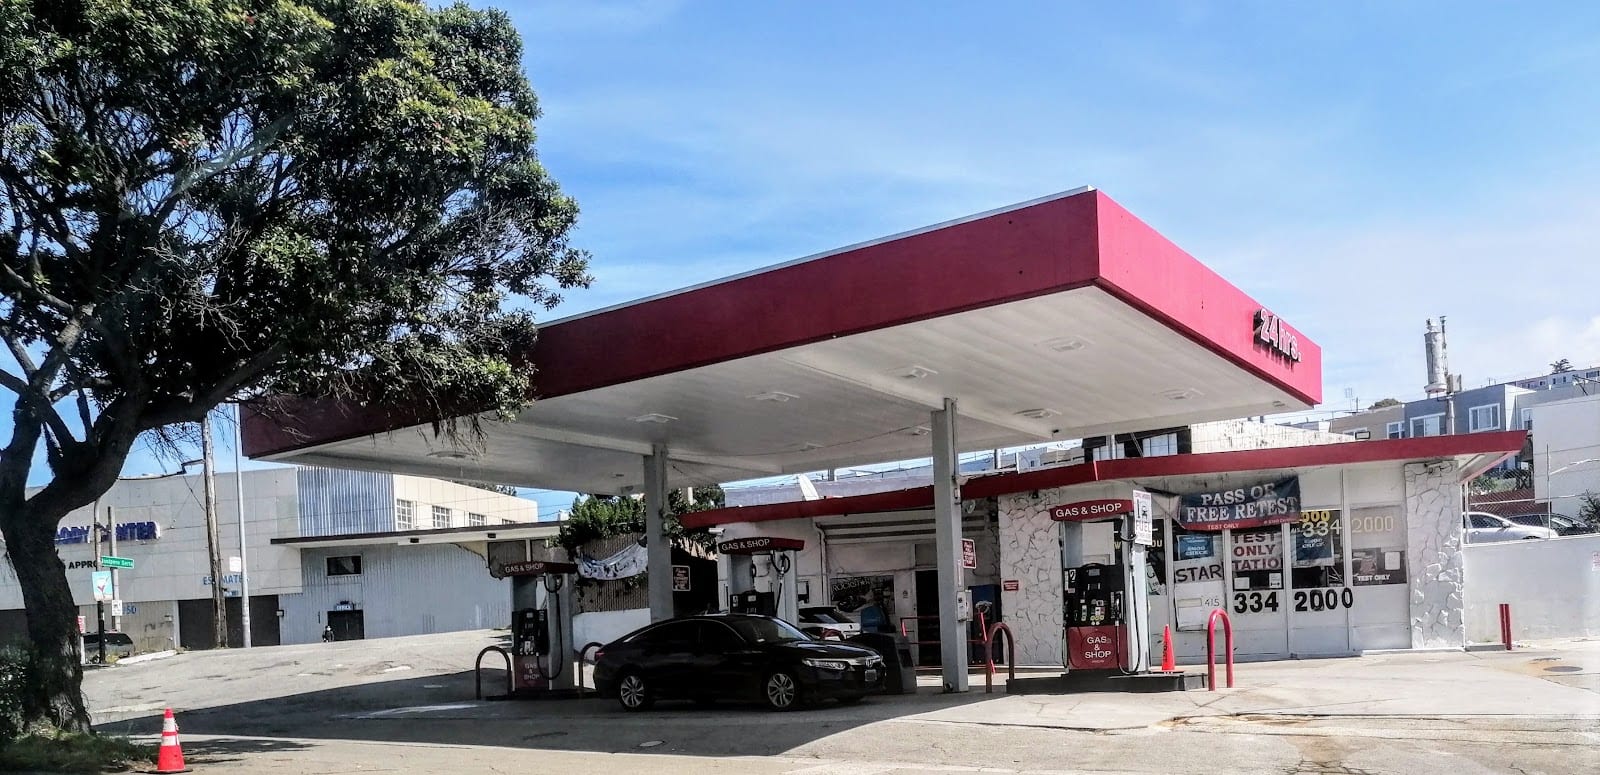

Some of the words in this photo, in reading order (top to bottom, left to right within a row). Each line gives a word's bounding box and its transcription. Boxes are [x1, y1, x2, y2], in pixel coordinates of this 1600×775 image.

[1201, 488, 1246, 506] PASS
[1055, 507, 1079, 518] GAS
[1081, 506, 1089, 515] &
[1090, 502, 1122, 515] SHOP
[1186, 506, 1231, 523] FREE
[1234, 496, 1298, 520] RETEST
[1301, 518, 1342, 538] 334
[1351, 515, 1395, 534] 2000
[721, 541, 740, 551] GAS
[740, 541, 746, 549] &
[746, 538, 771, 548] SHOP
[1230, 533, 1277, 544] TEST
[1233, 544, 1277, 557] ONLY
[504, 565, 520, 574] GAS
[525, 562, 545, 571] SHOP
[1175, 563, 1223, 583] STAR
[1204, 598, 1220, 607] 415
[1234, 591, 1280, 614] 334
[1293, 587, 1354, 612] 2000
[1086, 636, 1107, 644] GAS
[1094, 643, 1101, 651] &
[1084, 650, 1112, 659] SHOP
